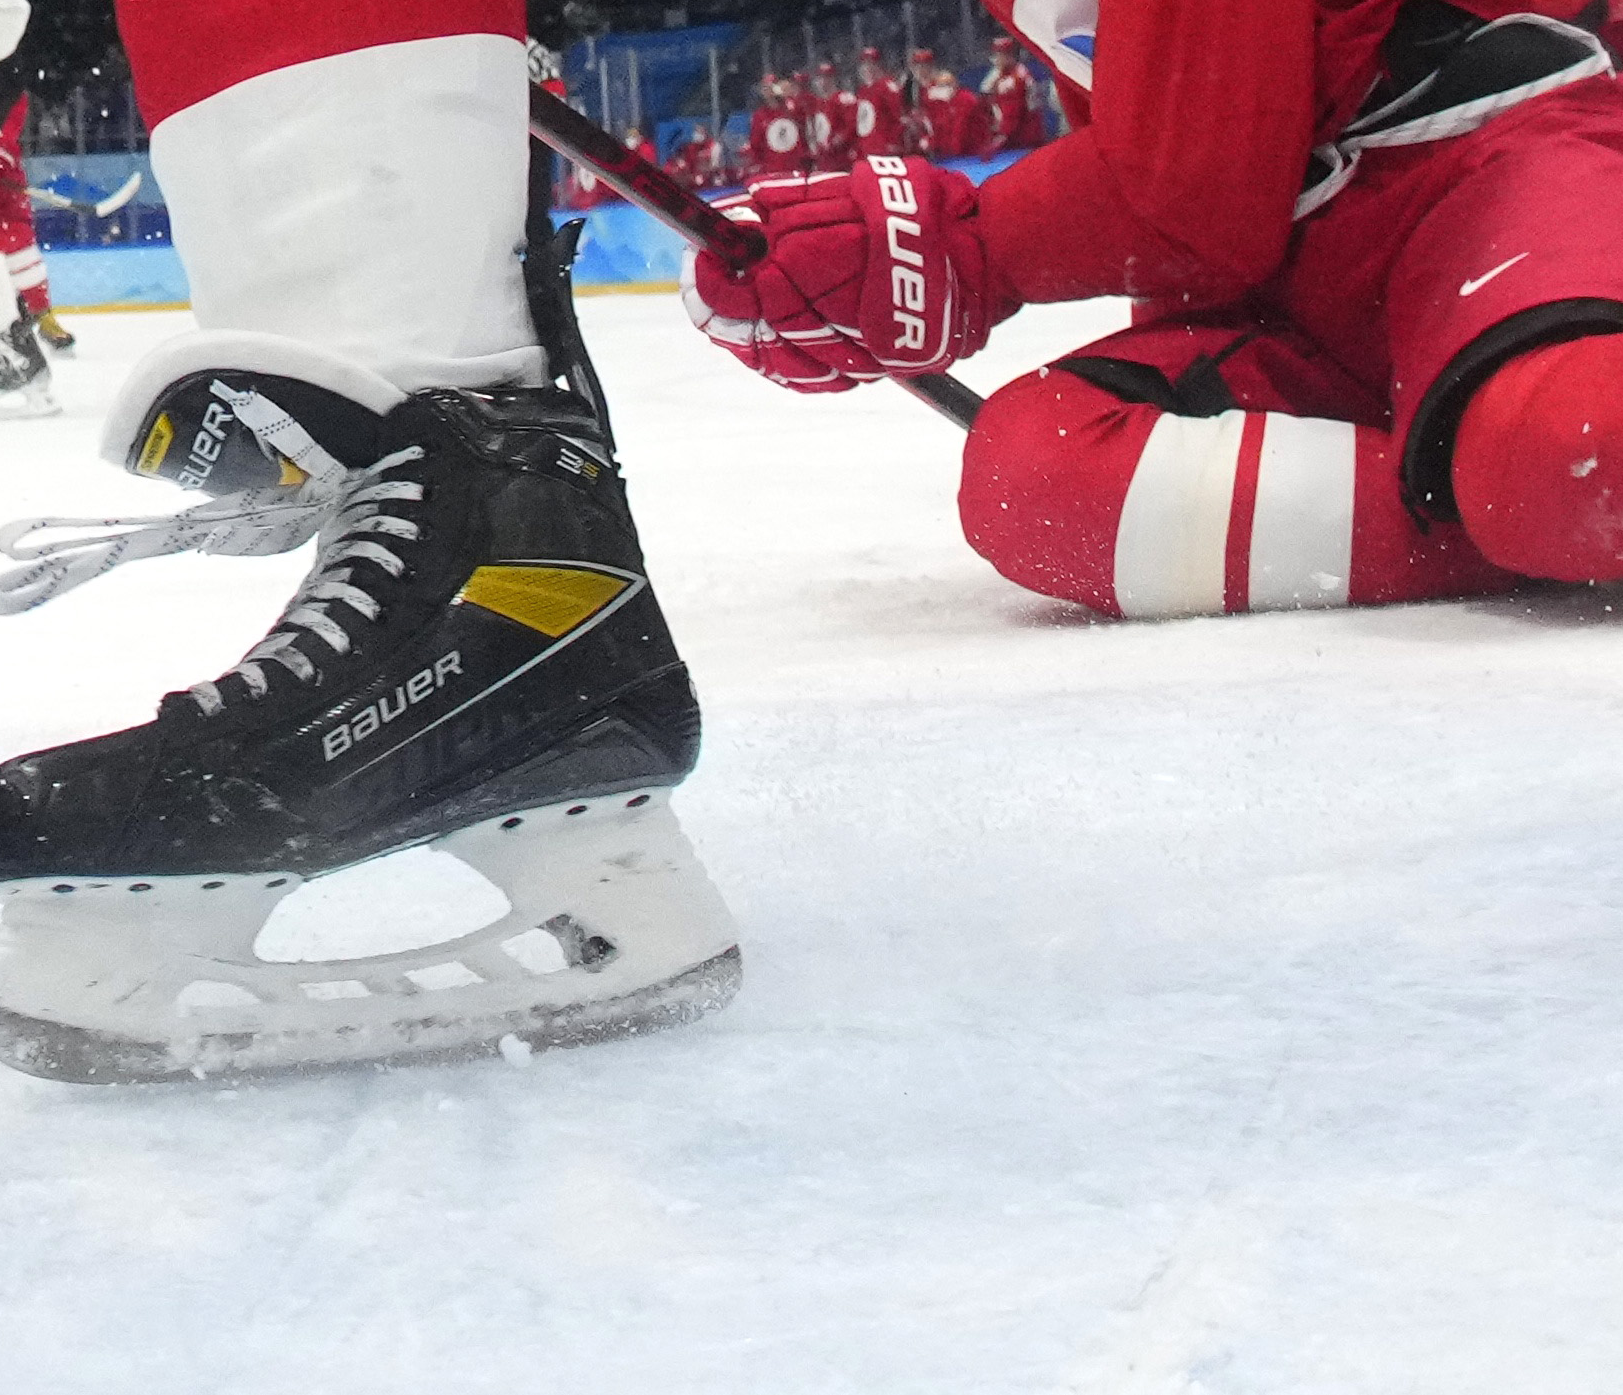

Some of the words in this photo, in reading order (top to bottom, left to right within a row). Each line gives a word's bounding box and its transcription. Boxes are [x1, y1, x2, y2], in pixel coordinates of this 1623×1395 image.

[867, 154, 931, 353] BAUER
[175, 401, 236, 492] AUER
[321, 649, 464, 763] BAUER
